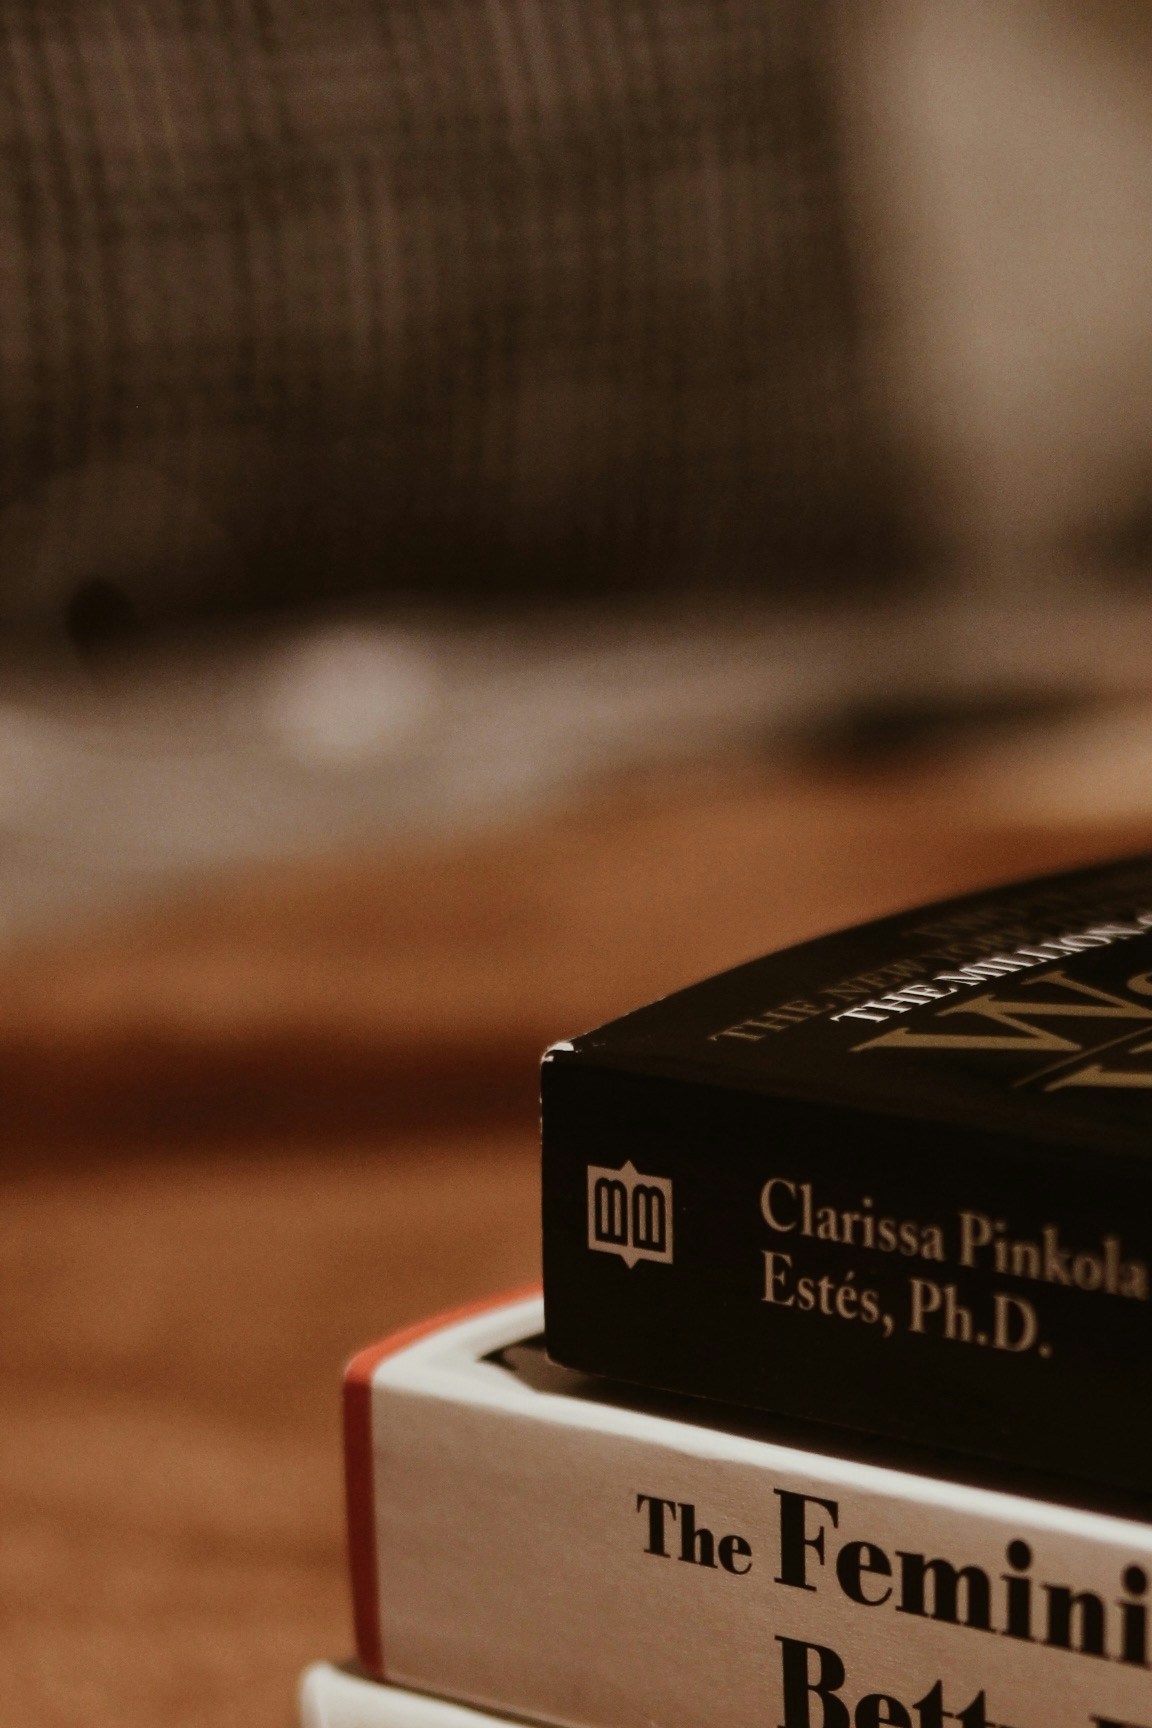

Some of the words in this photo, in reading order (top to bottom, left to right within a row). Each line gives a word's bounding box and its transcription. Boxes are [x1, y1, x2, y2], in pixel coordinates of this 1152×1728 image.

[830, 982, 958, 1024] THE
[759, 1177, 945, 1261] Clarissa
[959, 1211, 1148, 1300] Pinkola
[760, 1252, 894, 1336] Estés,
[909, 1279, 1052, 1357] Ph.D.
[636, 1495, 752, 1575] The
